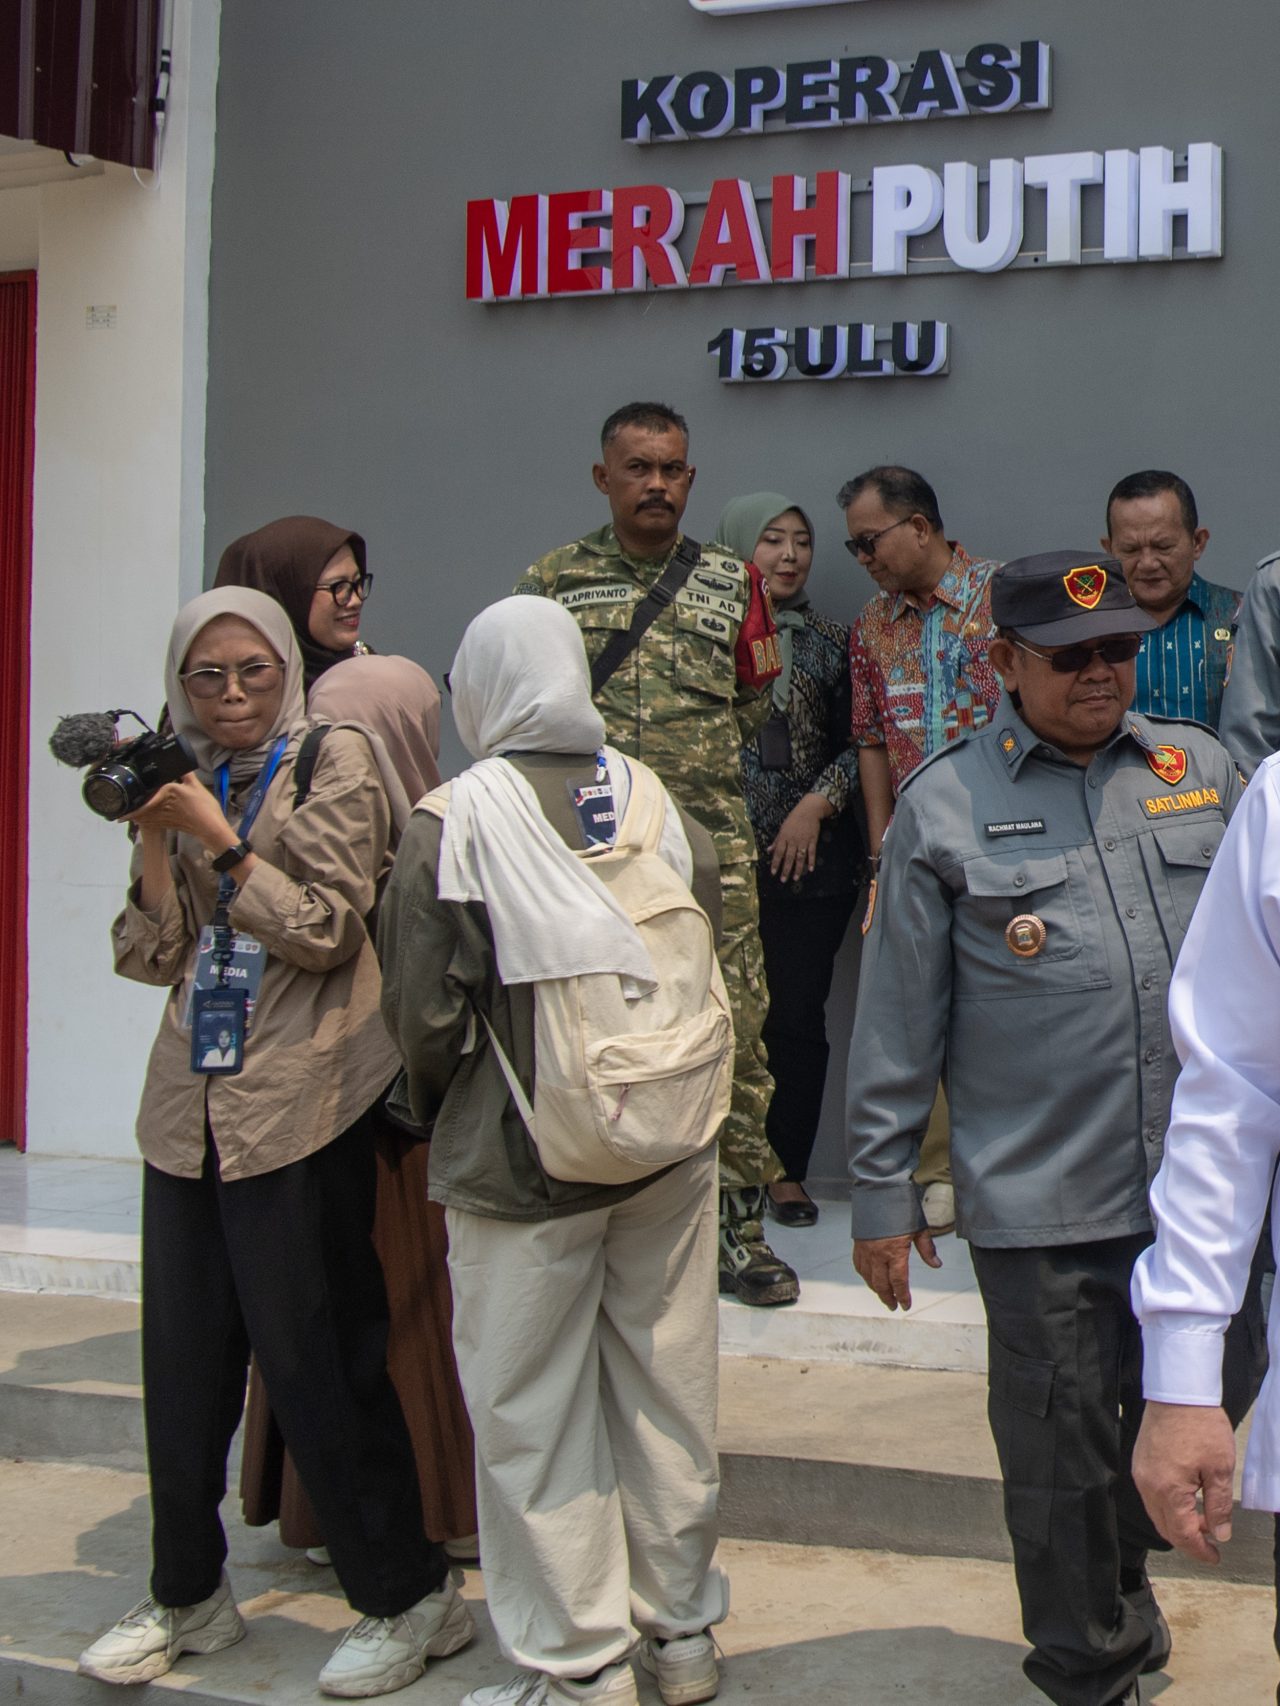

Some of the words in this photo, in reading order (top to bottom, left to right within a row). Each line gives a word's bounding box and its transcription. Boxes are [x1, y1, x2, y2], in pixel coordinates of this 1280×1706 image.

[621, 40, 1050, 143] KOPERASI
[466, 170, 851, 302] MERAH
[872, 142, 1222, 272] PUTIH
[708, 327, 788, 381] 15
[795, 320, 948, 380] ULU
[562, 588, 627, 605] N.APRIYANTO
[686, 592, 710, 606] TNI
[719, 601, 736, 614] AD
[1146, 788, 1219, 814] SATLINMAS
